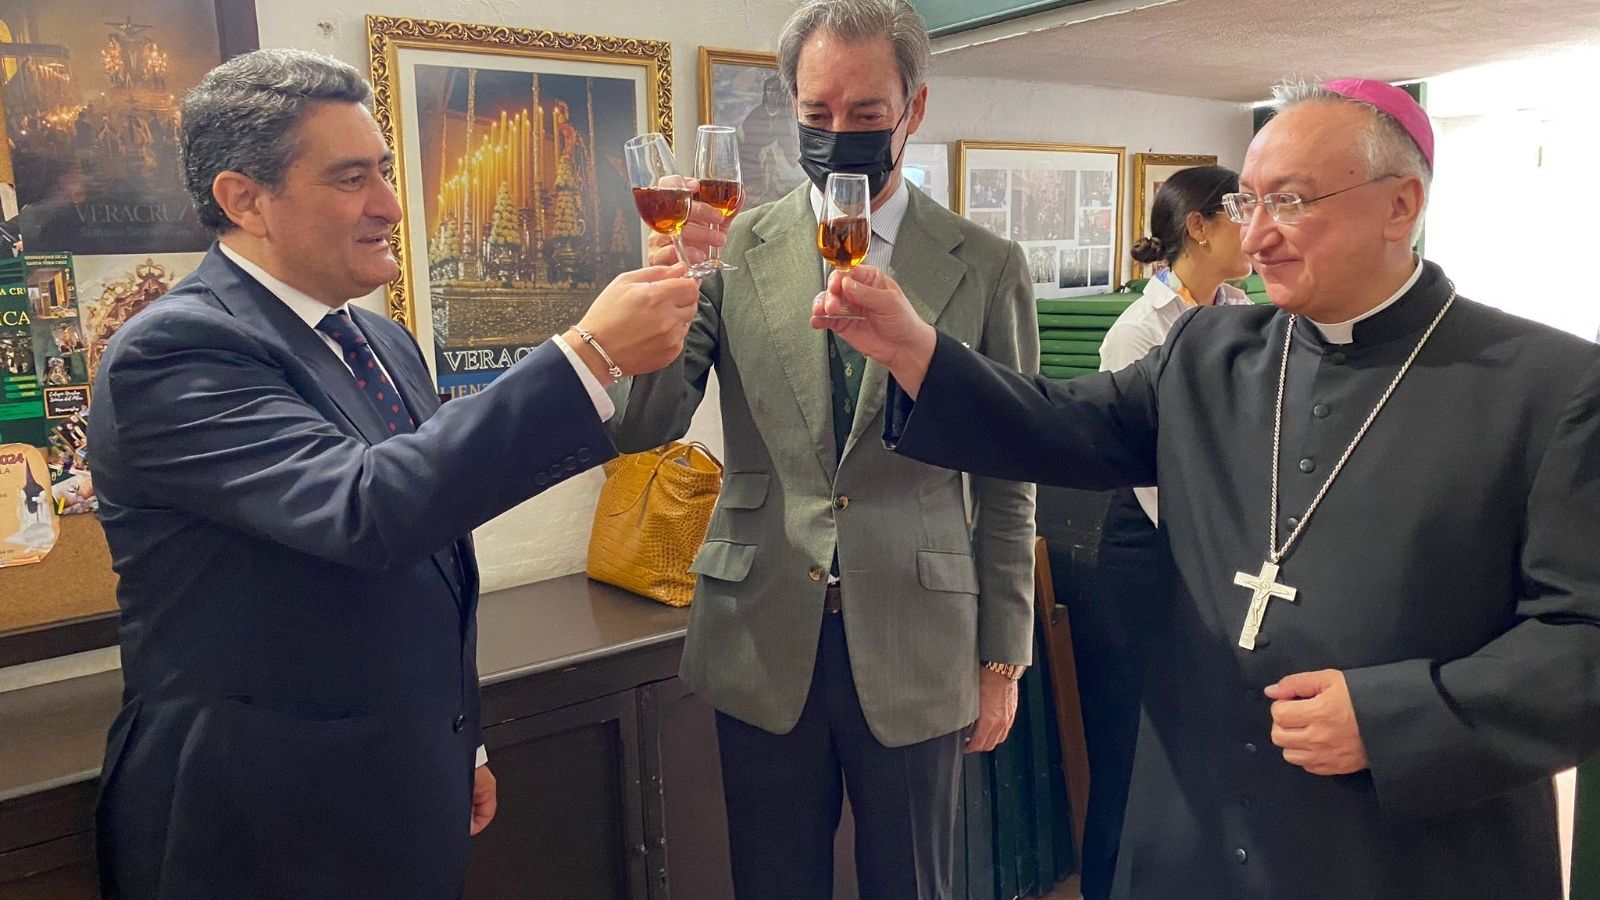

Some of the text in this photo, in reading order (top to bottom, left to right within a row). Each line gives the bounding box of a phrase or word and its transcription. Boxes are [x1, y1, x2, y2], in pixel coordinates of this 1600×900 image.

[74, 203, 189, 223] VERACRUZ
[443, 347, 538, 372] VERAC
[0, 453, 25, 465] 024
